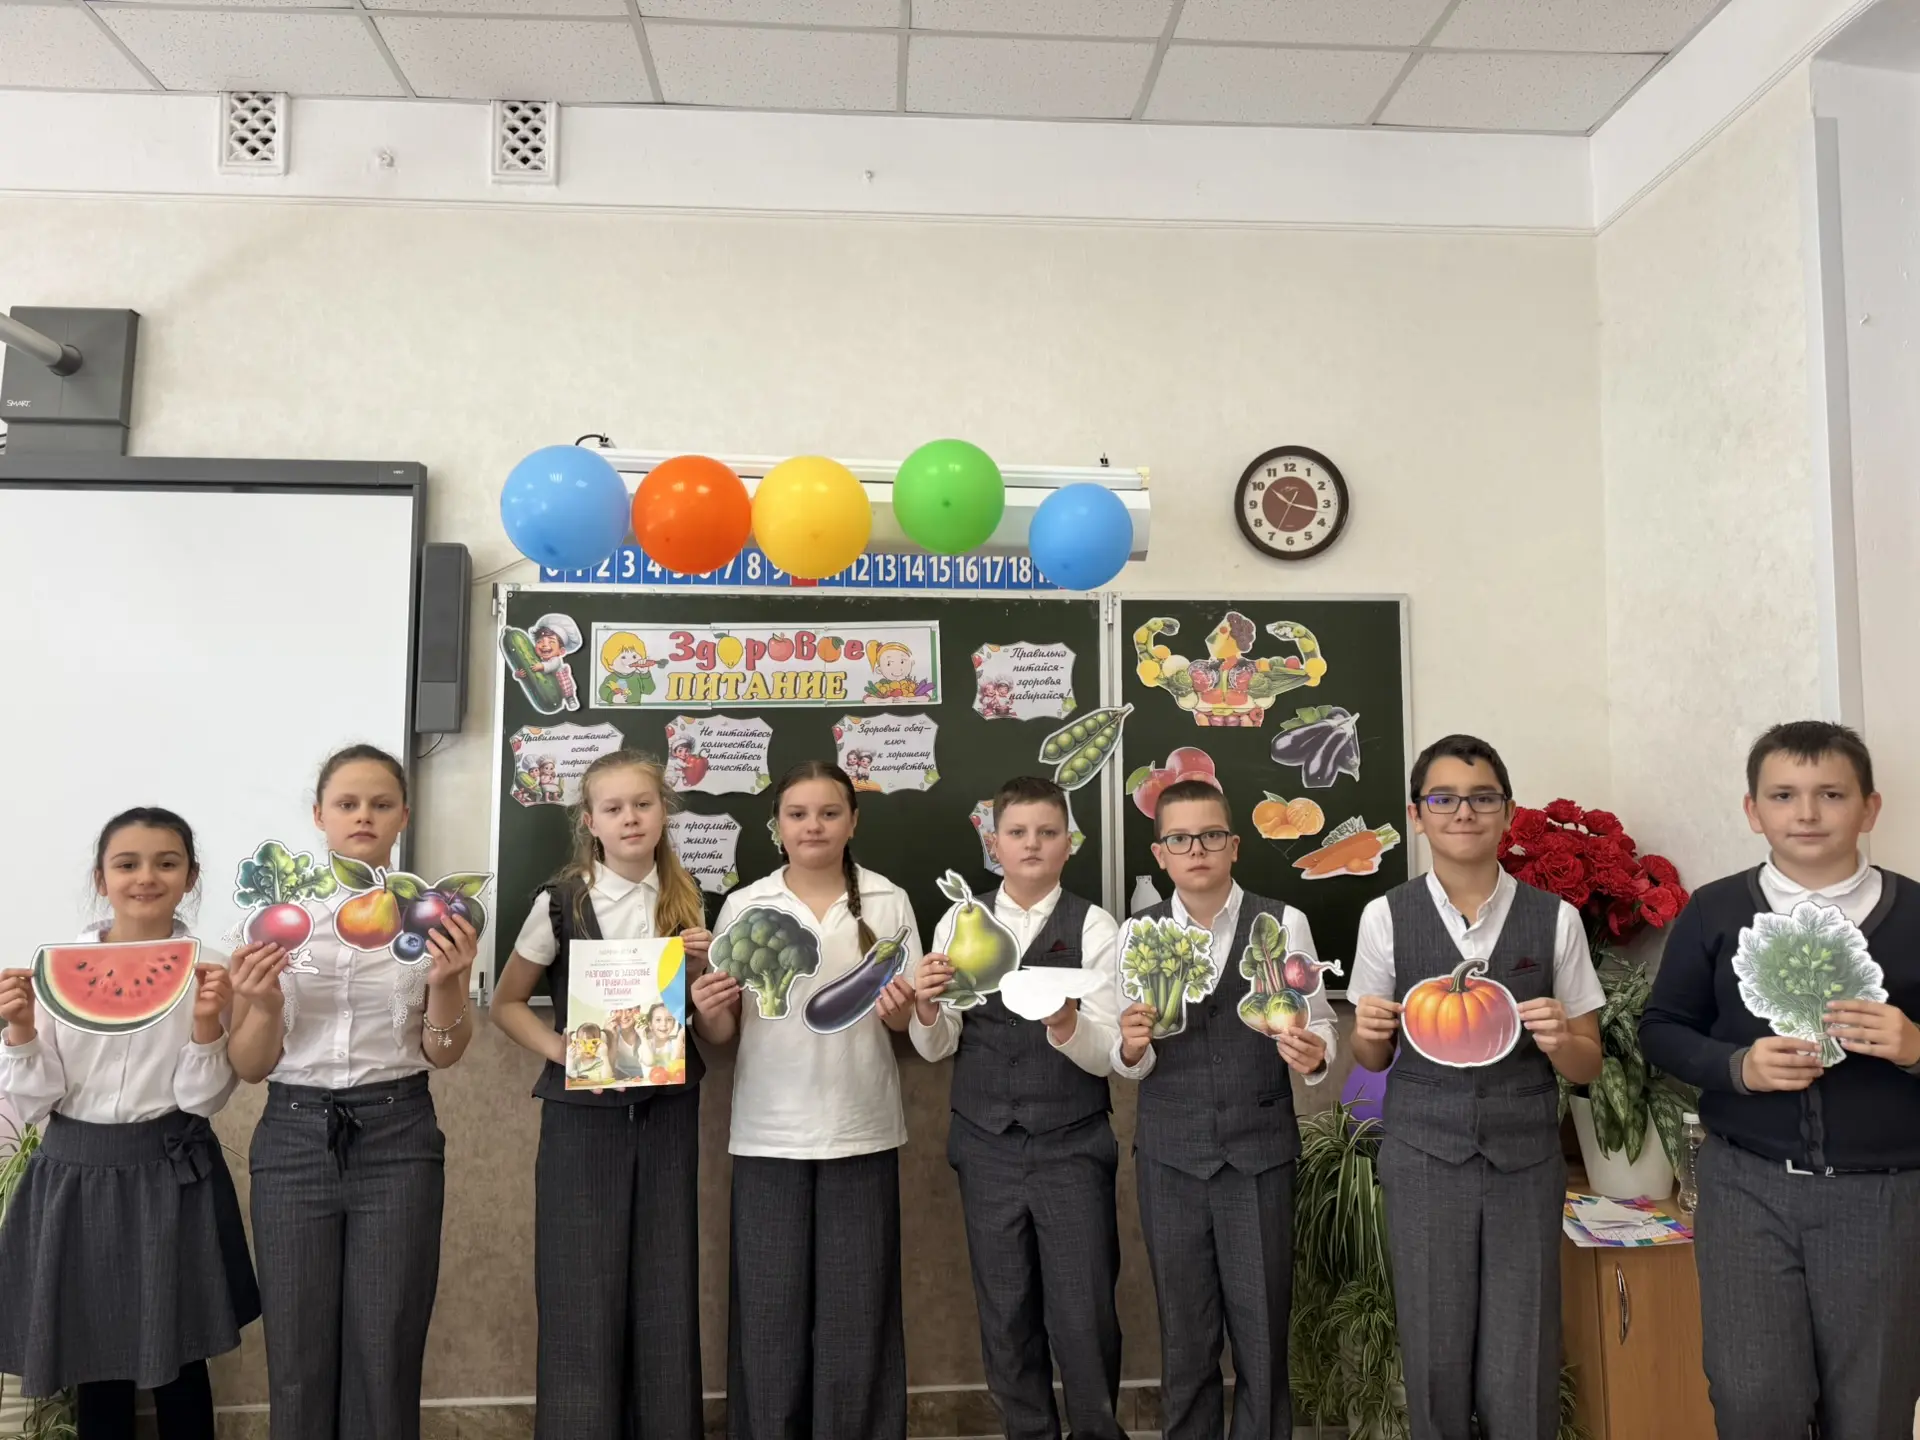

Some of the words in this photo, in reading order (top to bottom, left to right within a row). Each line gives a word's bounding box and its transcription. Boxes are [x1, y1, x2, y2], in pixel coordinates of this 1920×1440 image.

[1283, 463, 1296, 472] 12
[1266, 468, 1277, 477] 11
[1305, 468, 1311, 477] 1
[1252, 482, 1265, 491] 10
[1318, 481, 1326, 490] 2
[1249, 500, 1258, 509] 9
[1322, 500, 1331, 508] 3
[1254, 519, 1263, 527] 8
[1317, 518, 1326, 527] 4
[1268, 532, 1276, 541] 7
[1304, 532, 1313, 541] 5
[1286, 537, 1295, 546] 6
[622, 550, 635, 578] 3
[747, 552, 761, 579] 8
[875, 554, 896, 581] 13
[902, 555, 924, 582] 14
[929, 555, 950, 582] 15
[956, 555, 978, 583] 16
[982, 556, 1004, 583] 17
[1009, 556, 1031, 583] 18
[1010, 647, 1067, 660] Правильно
[665, 671, 848, 701] ПИТАНИЕ
[1016, 676, 1062, 689] здоровья
[699, 726, 714, 737] Не
[716, 728, 772, 738] питайтесь
[857, 723, 901, 735] Здоровый
[570, 744, 600, 753] основа
[700, 740, 767, 750] количеством,
[886, 749, 931, 760] хорошему
[707, 762, 761, 772] качеством
[869, 761, 935, 773] самочувствию
[684, 821, 738, 833] продлить
[681, 850, 723, 862] укроти
